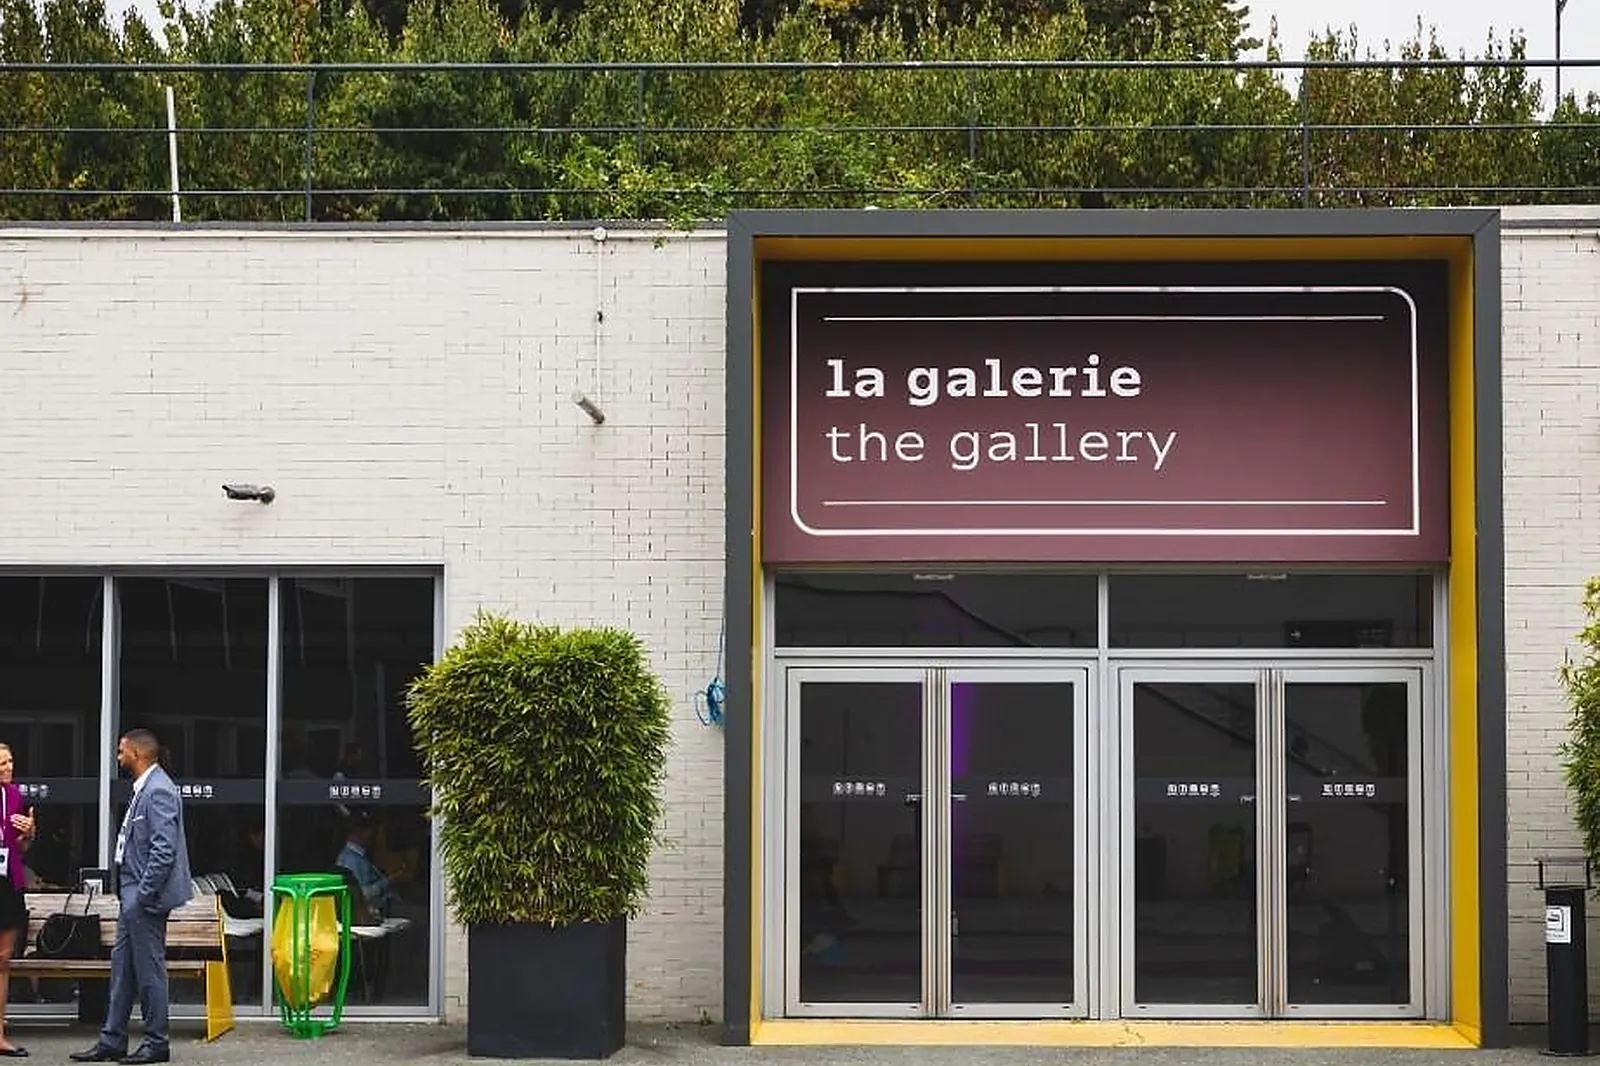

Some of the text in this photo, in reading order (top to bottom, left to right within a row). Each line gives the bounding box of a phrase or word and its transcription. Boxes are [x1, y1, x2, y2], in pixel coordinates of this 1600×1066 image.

[825, 354, 1142, 407] la galerie
[825, 423, 1178, 471] the gallery
